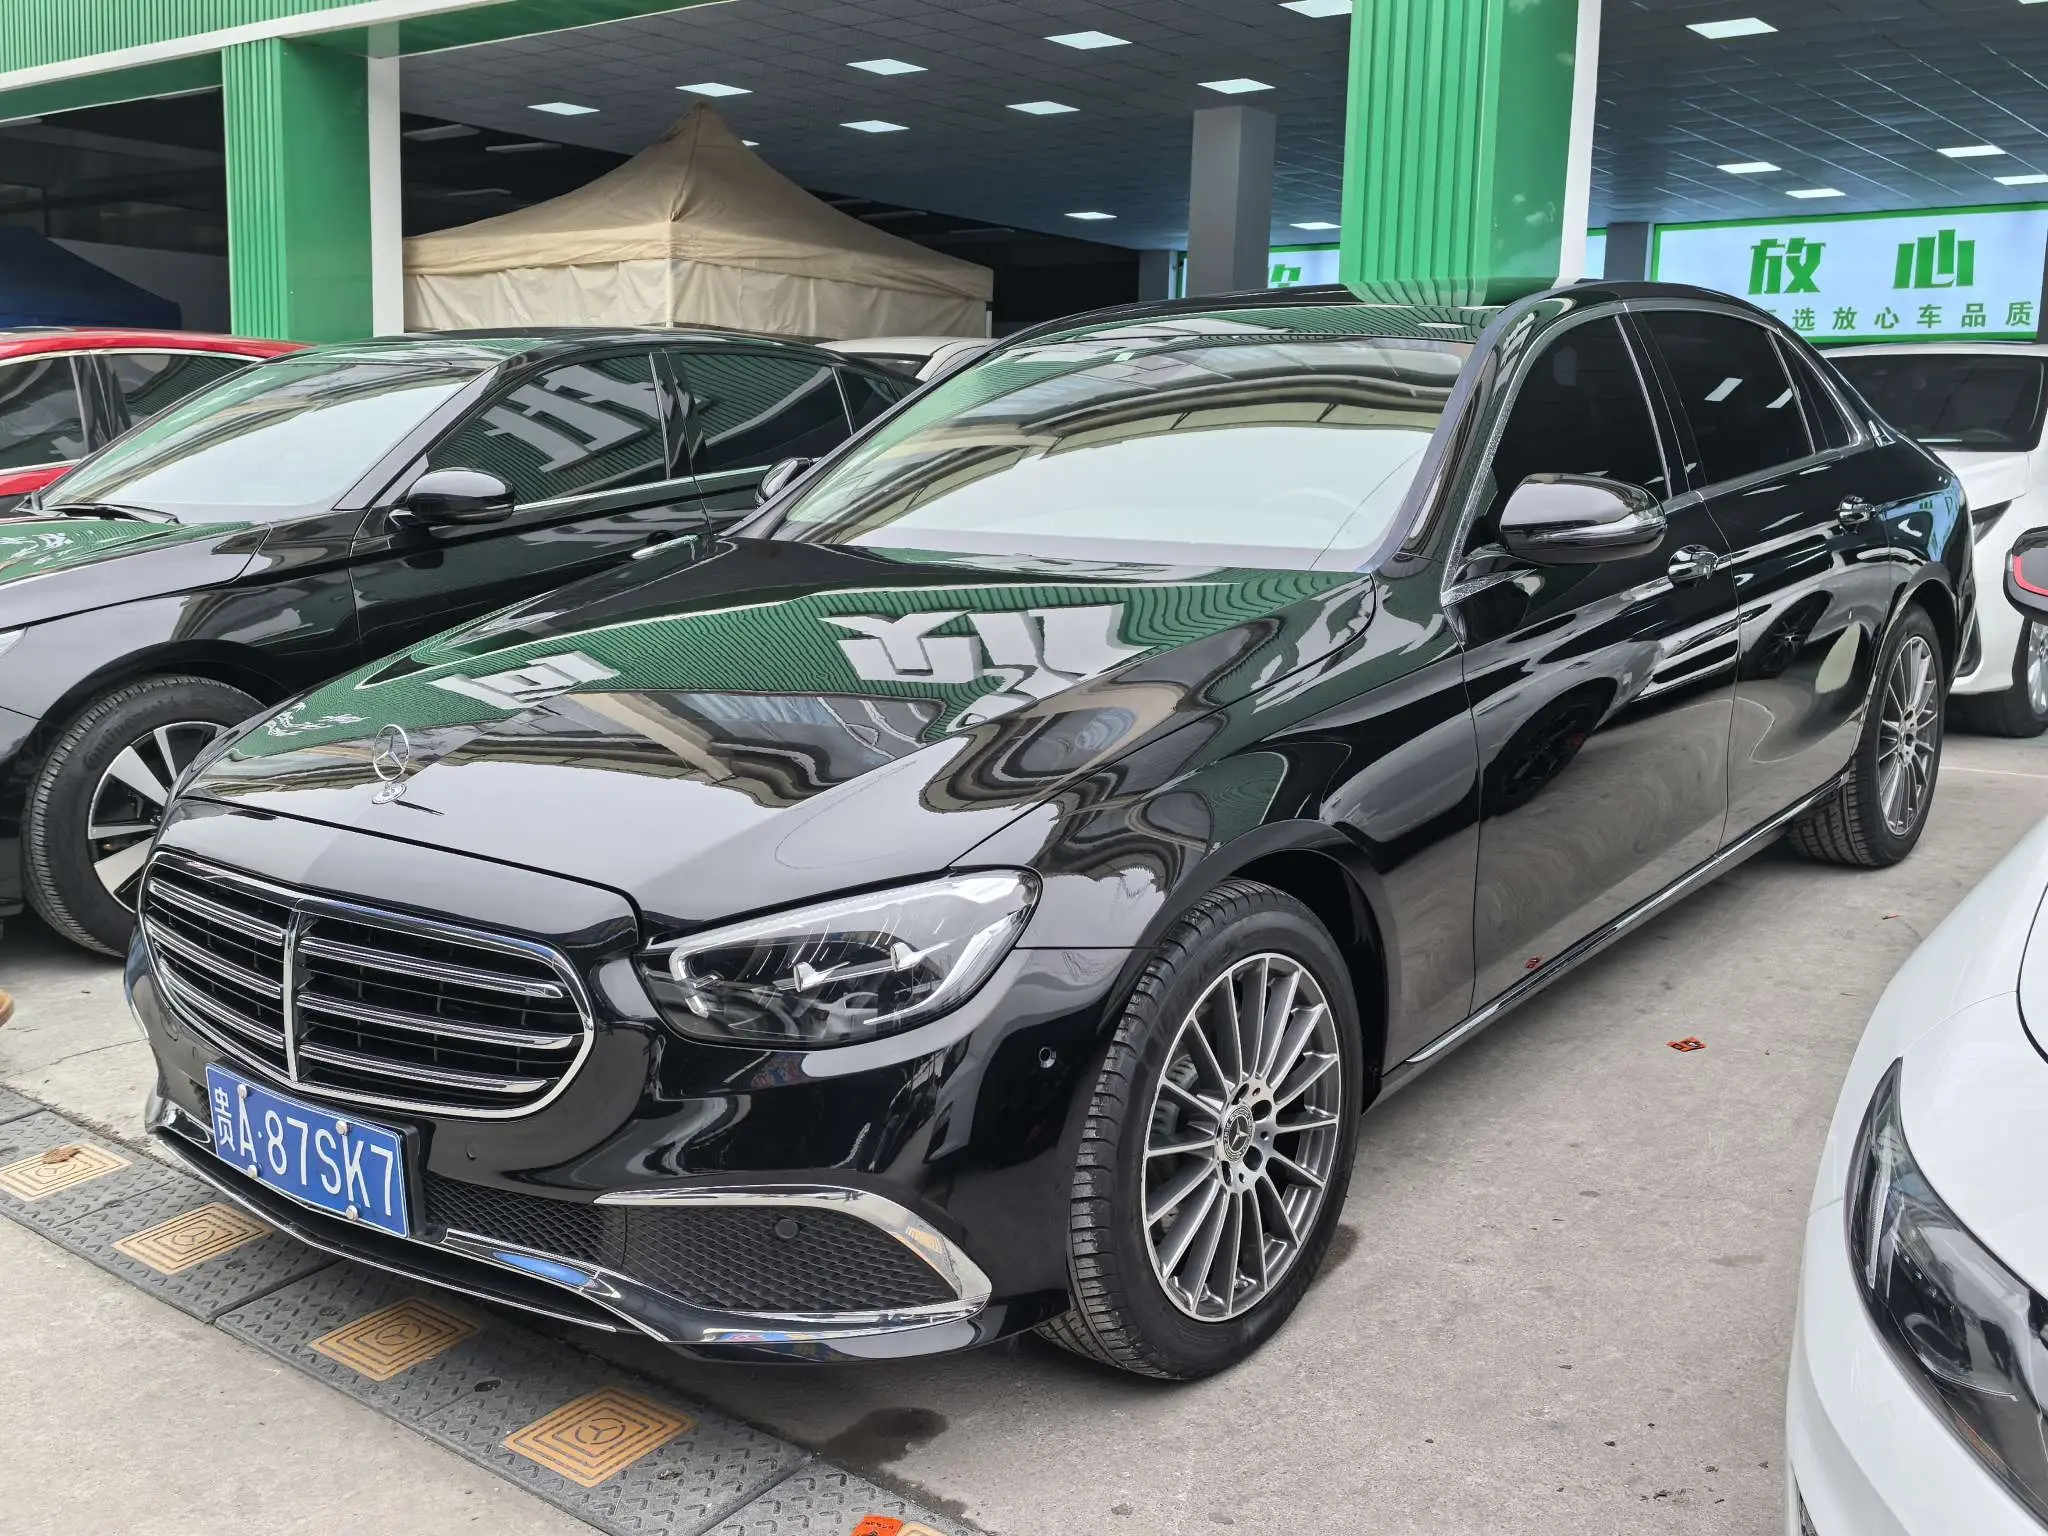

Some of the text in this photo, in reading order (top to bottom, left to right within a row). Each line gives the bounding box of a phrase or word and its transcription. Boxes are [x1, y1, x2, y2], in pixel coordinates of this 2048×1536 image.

[1769, 301, 2034, 331] 选放心车品质
